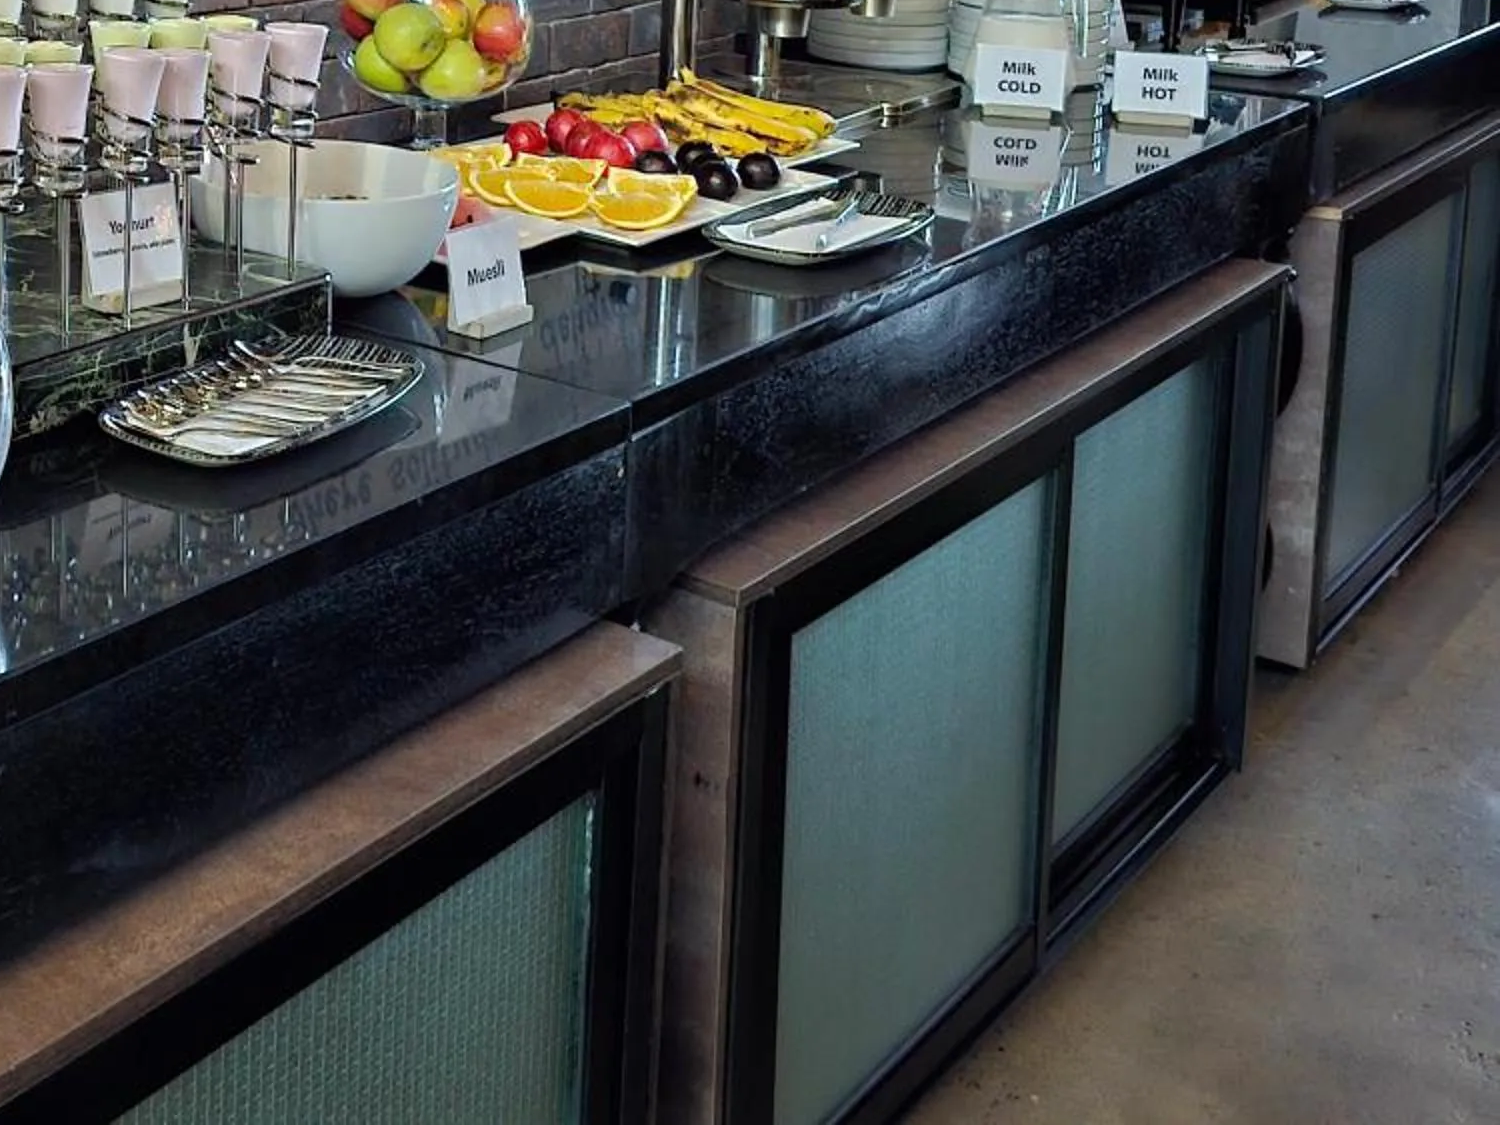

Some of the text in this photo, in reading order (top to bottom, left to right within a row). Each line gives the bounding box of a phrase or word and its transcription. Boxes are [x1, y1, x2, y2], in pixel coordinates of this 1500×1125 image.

[1002, 61, 1037, 76] Milk
[1143, 67, 1178, 81] Milk
[998, 80, 1041, 93] COLD
[1142, 87, 1177, 100] HOT
[467, 258, 505, 286] Muesli
